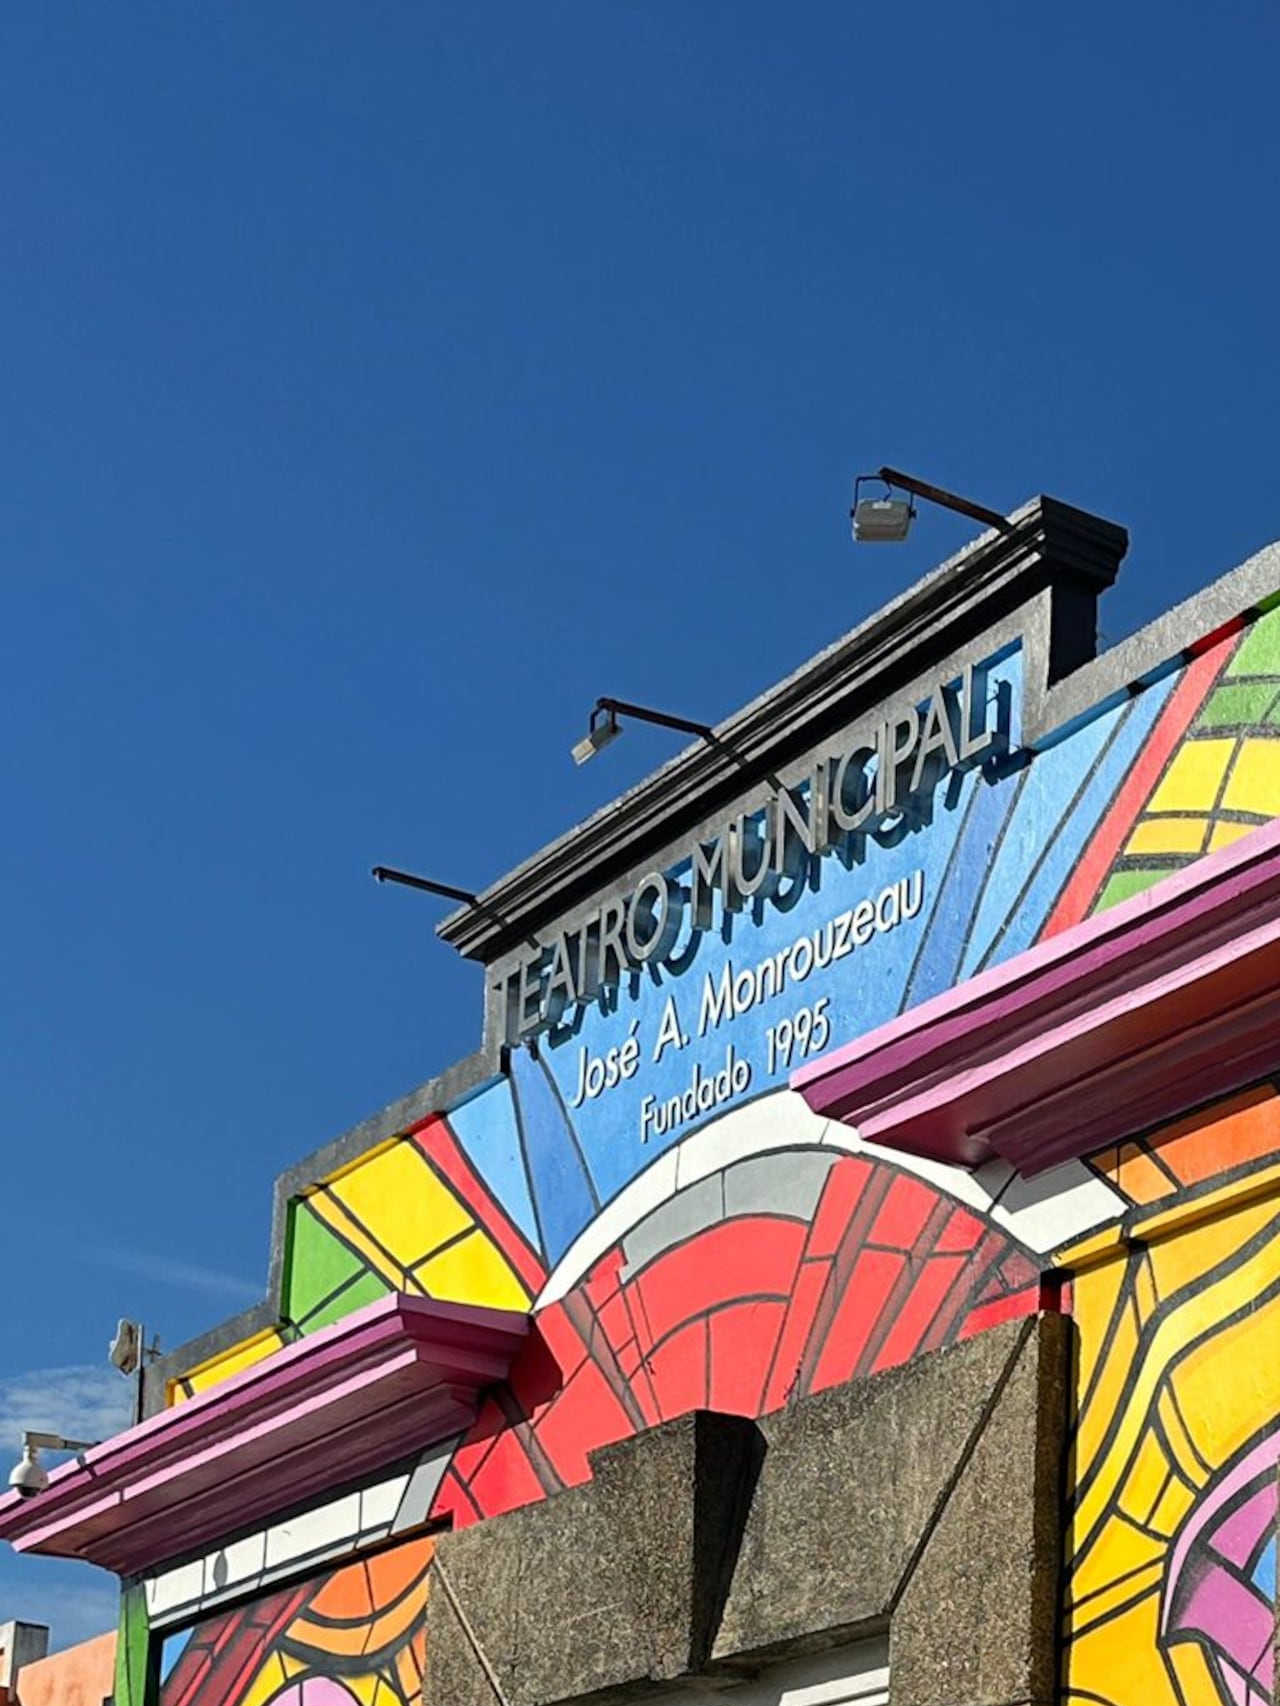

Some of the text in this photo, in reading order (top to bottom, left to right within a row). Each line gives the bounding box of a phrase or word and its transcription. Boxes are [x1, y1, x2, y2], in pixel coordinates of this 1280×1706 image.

[491, 663, 1000, 1050] TEATRO MUNICIPAL
[570, 868, 924, 1108] José A. Monrouzeau
[640, 996, 831, 1144] Fundado 1995
